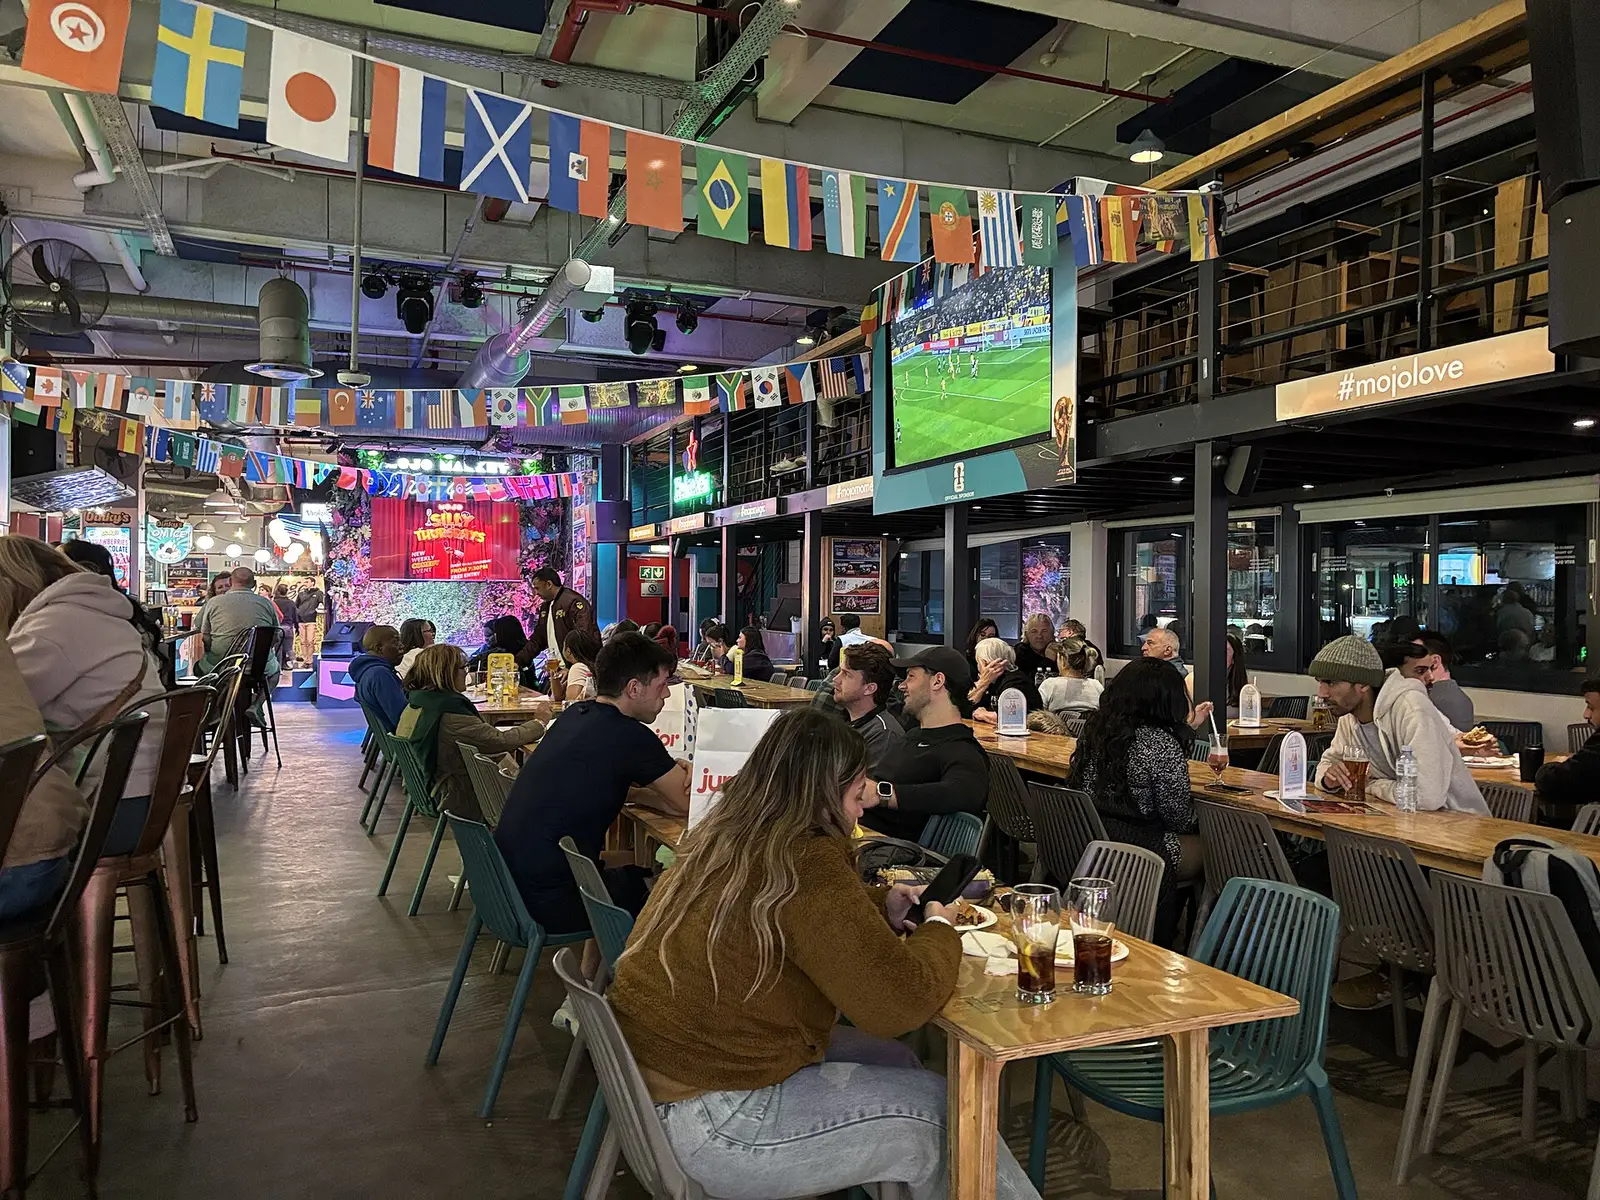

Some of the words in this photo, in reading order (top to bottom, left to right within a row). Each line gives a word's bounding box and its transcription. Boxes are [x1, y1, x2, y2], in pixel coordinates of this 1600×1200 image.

[1337, 356, 1464, 400] #mojolove
[430, 511, 475, 527] SILLY
[411, 555, 435, 563] WEEKLY
[412, 567, 432, 575] EVENT
[451, 566, 467, 574] FROM
[468, 564, 488, 572] 7:30PM
